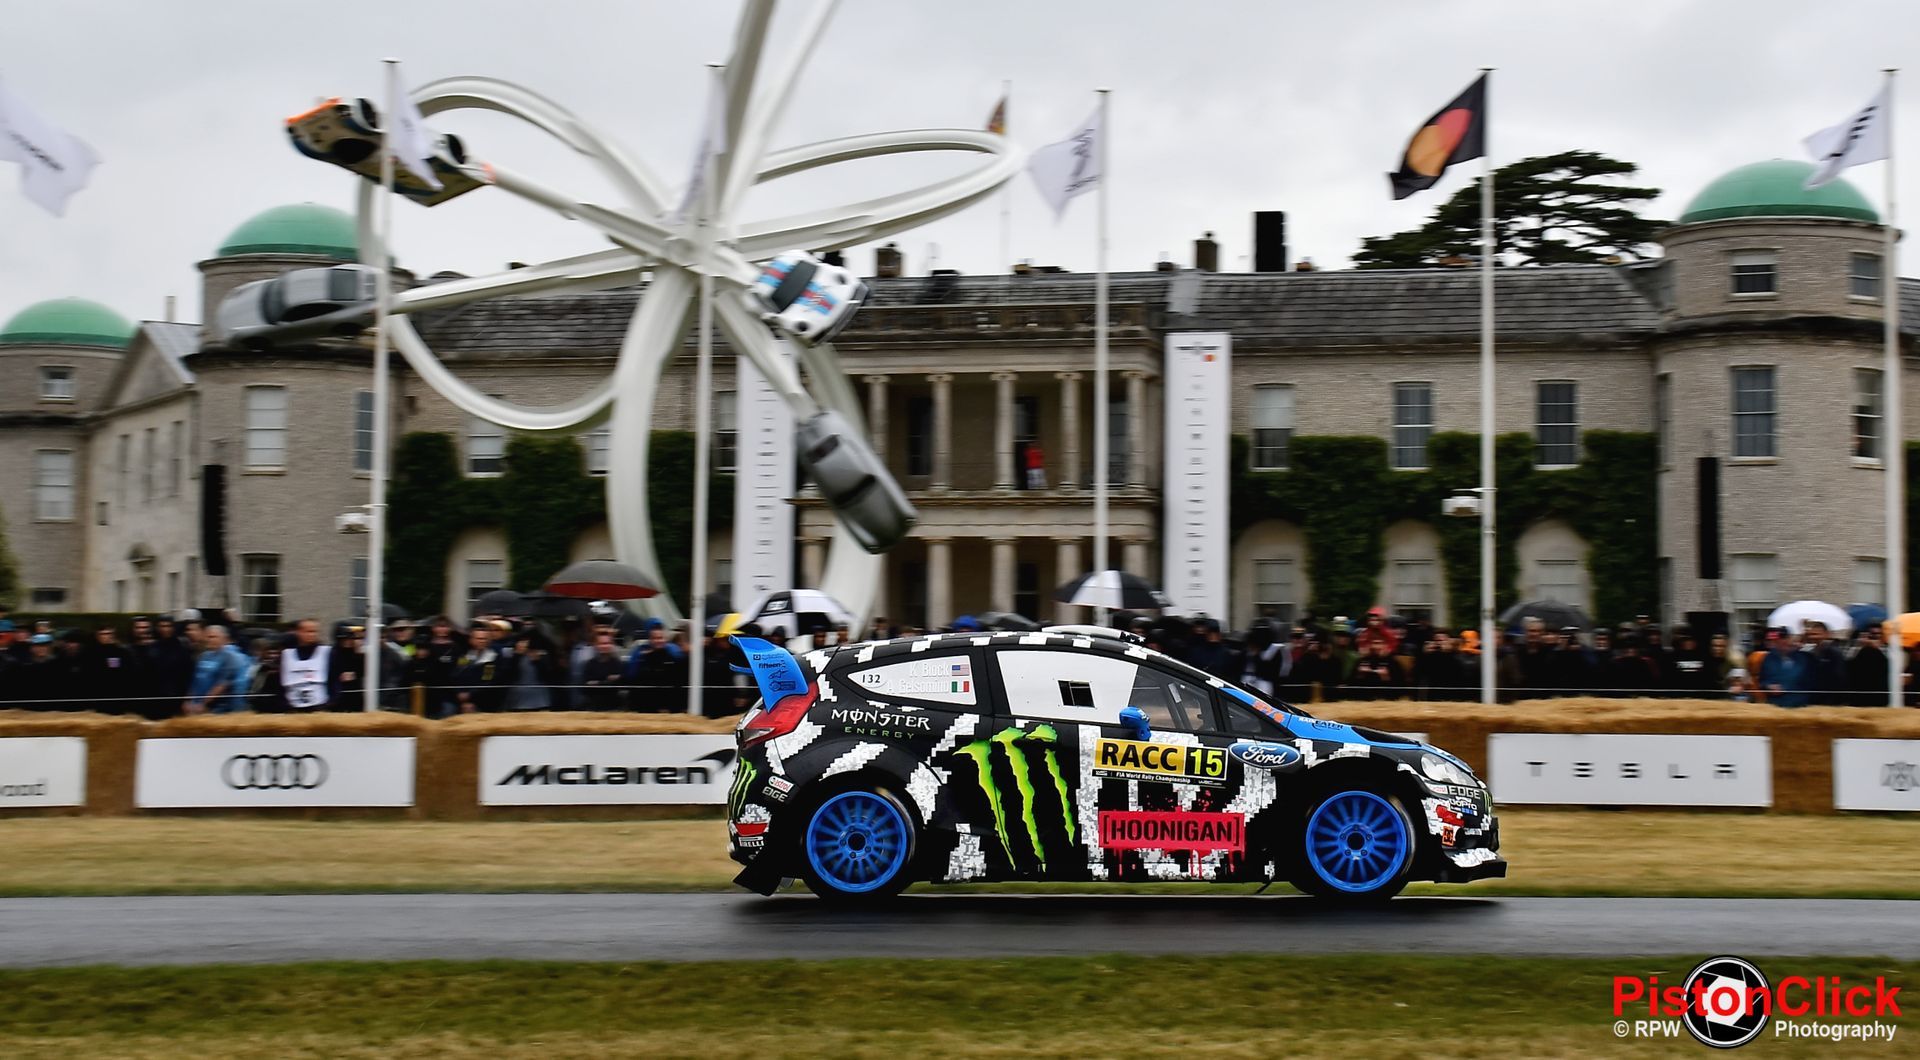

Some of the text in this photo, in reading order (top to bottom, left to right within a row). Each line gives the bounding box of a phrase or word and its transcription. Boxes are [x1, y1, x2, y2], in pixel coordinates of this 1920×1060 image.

[862, 674, 881, 683] 132
[844, 726, 914, 739] ENERGY
[1101, 742, 1223, 777] RACC 15
[1242, 745, 1288, 765] Ford
[495, 764, 712, 785] McLaren
[1525, 760, 1739, 779] TESLA
[1448, 785, 1480, 799] EDGE
